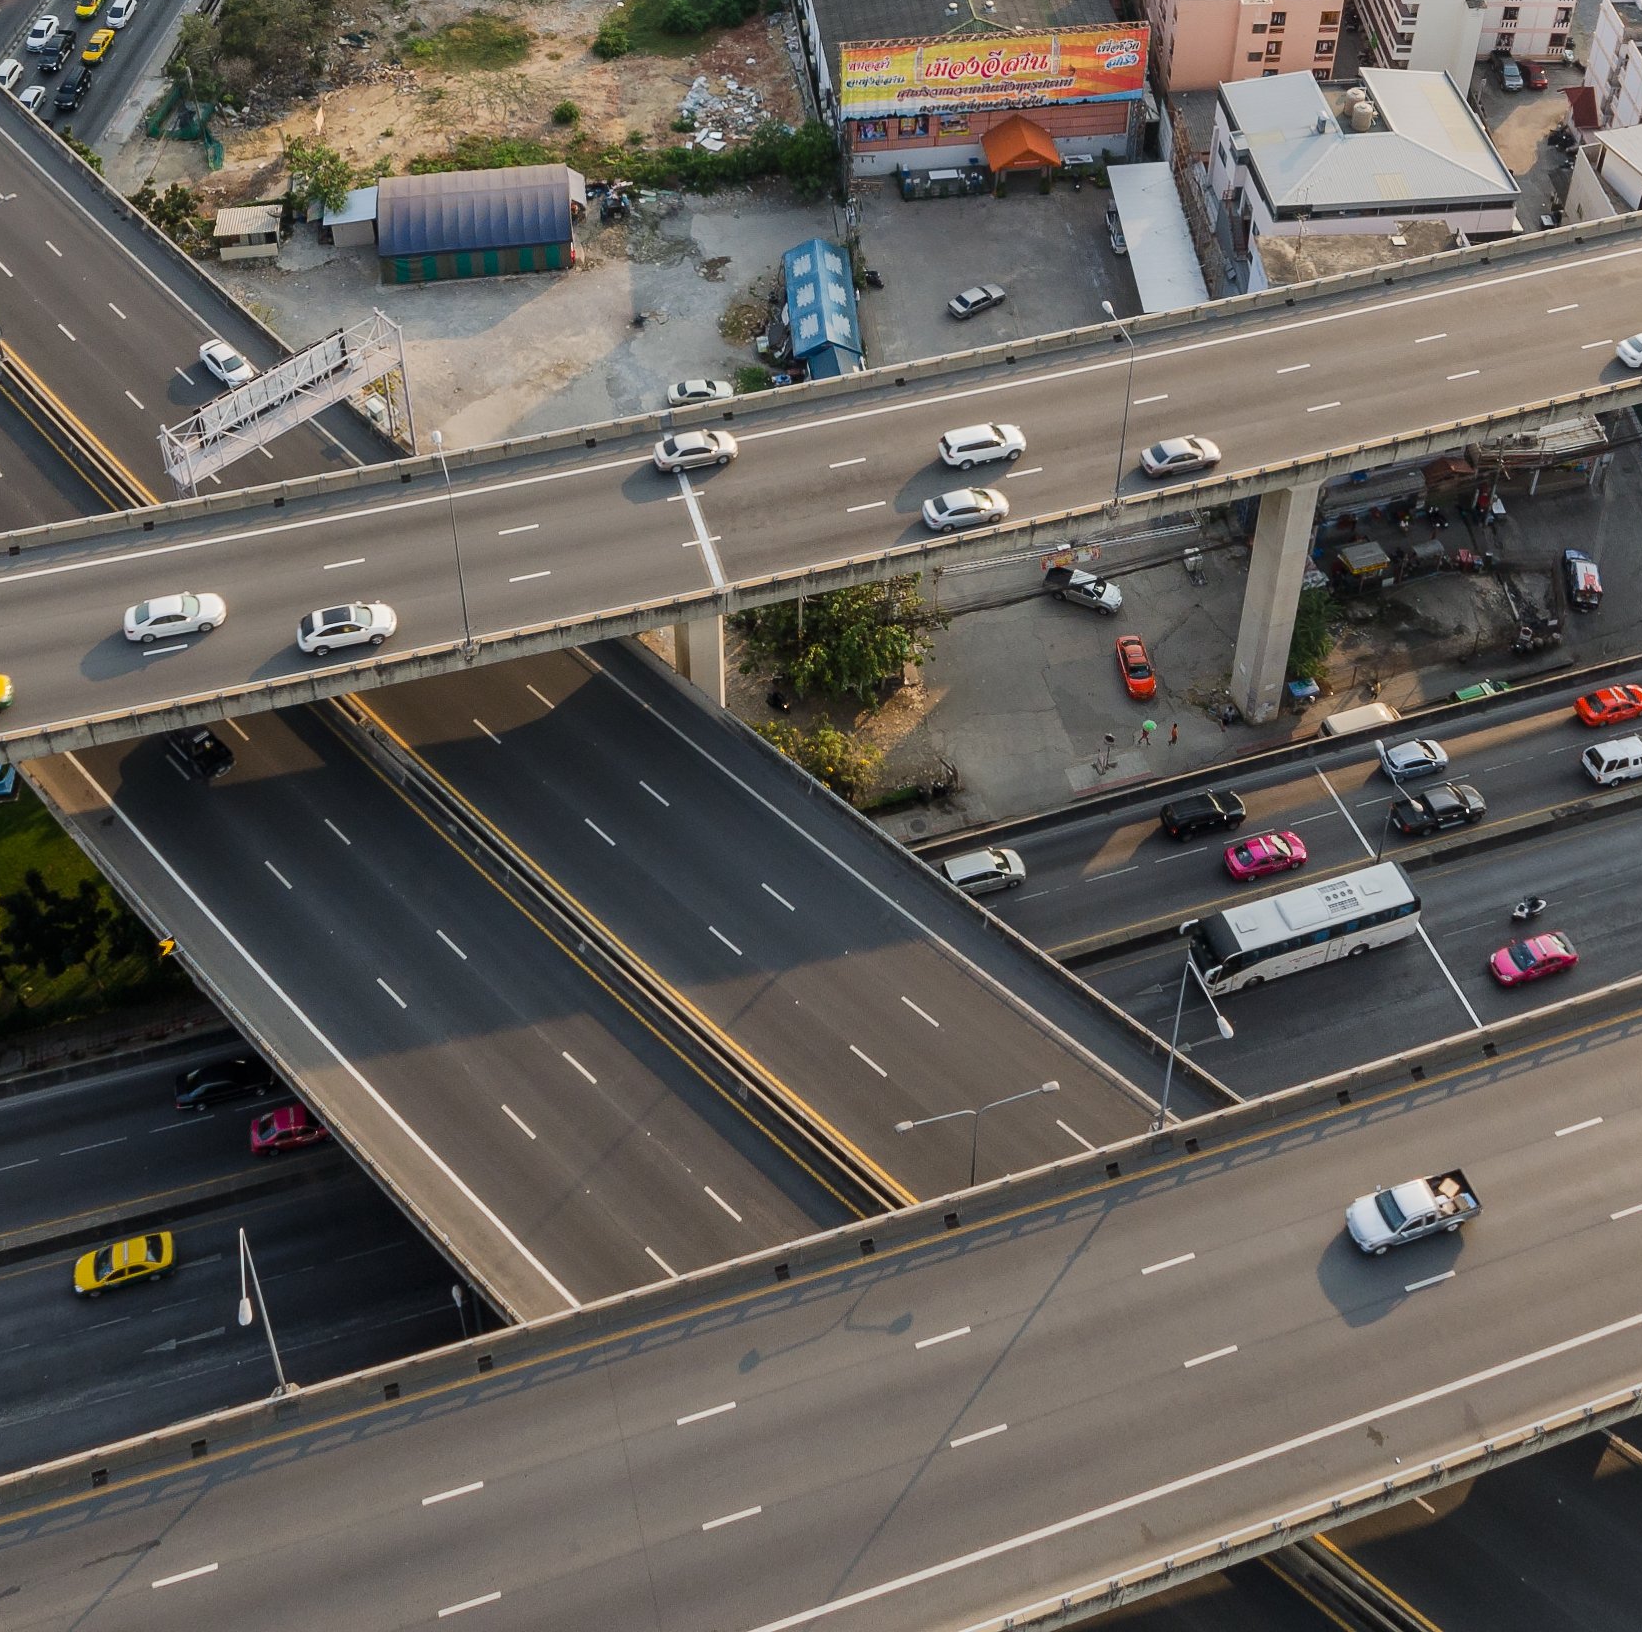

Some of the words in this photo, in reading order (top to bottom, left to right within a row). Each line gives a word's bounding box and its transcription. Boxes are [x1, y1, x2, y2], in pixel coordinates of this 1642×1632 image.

[1097, 39, 1140, 54] เพื่อชีวิต
[925, 50, 1049, 80] เมืองอีสาน
